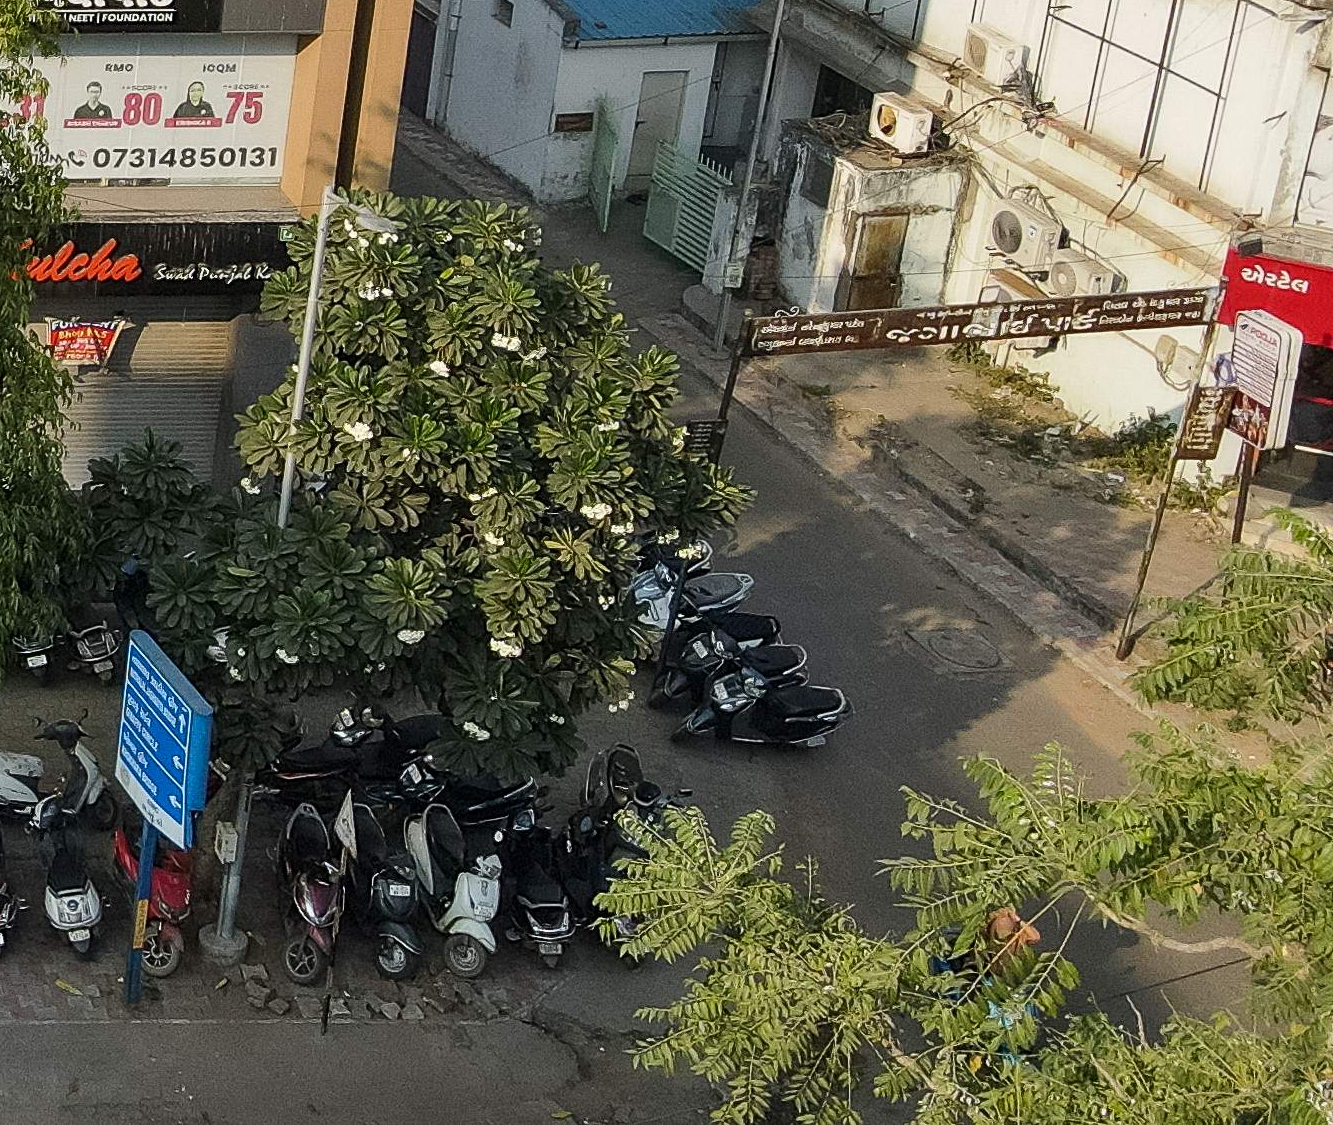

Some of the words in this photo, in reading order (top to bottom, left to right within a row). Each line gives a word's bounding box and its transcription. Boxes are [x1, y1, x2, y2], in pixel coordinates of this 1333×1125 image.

[69, 13, 95, 22] NEET
[102, 12, 173, 22] FOUNDATION
[122, 92, 163, 125] 80
[225, 91, 264, 125] 75
[92, 146, 278, 168] 07314850131
[13, 238, 142, 283] ulcha
[155, 263, 194, 280] Swad
[198, 263, 251, 284] Punjab
[1241, 265, 1309, 294] એરટેલ
